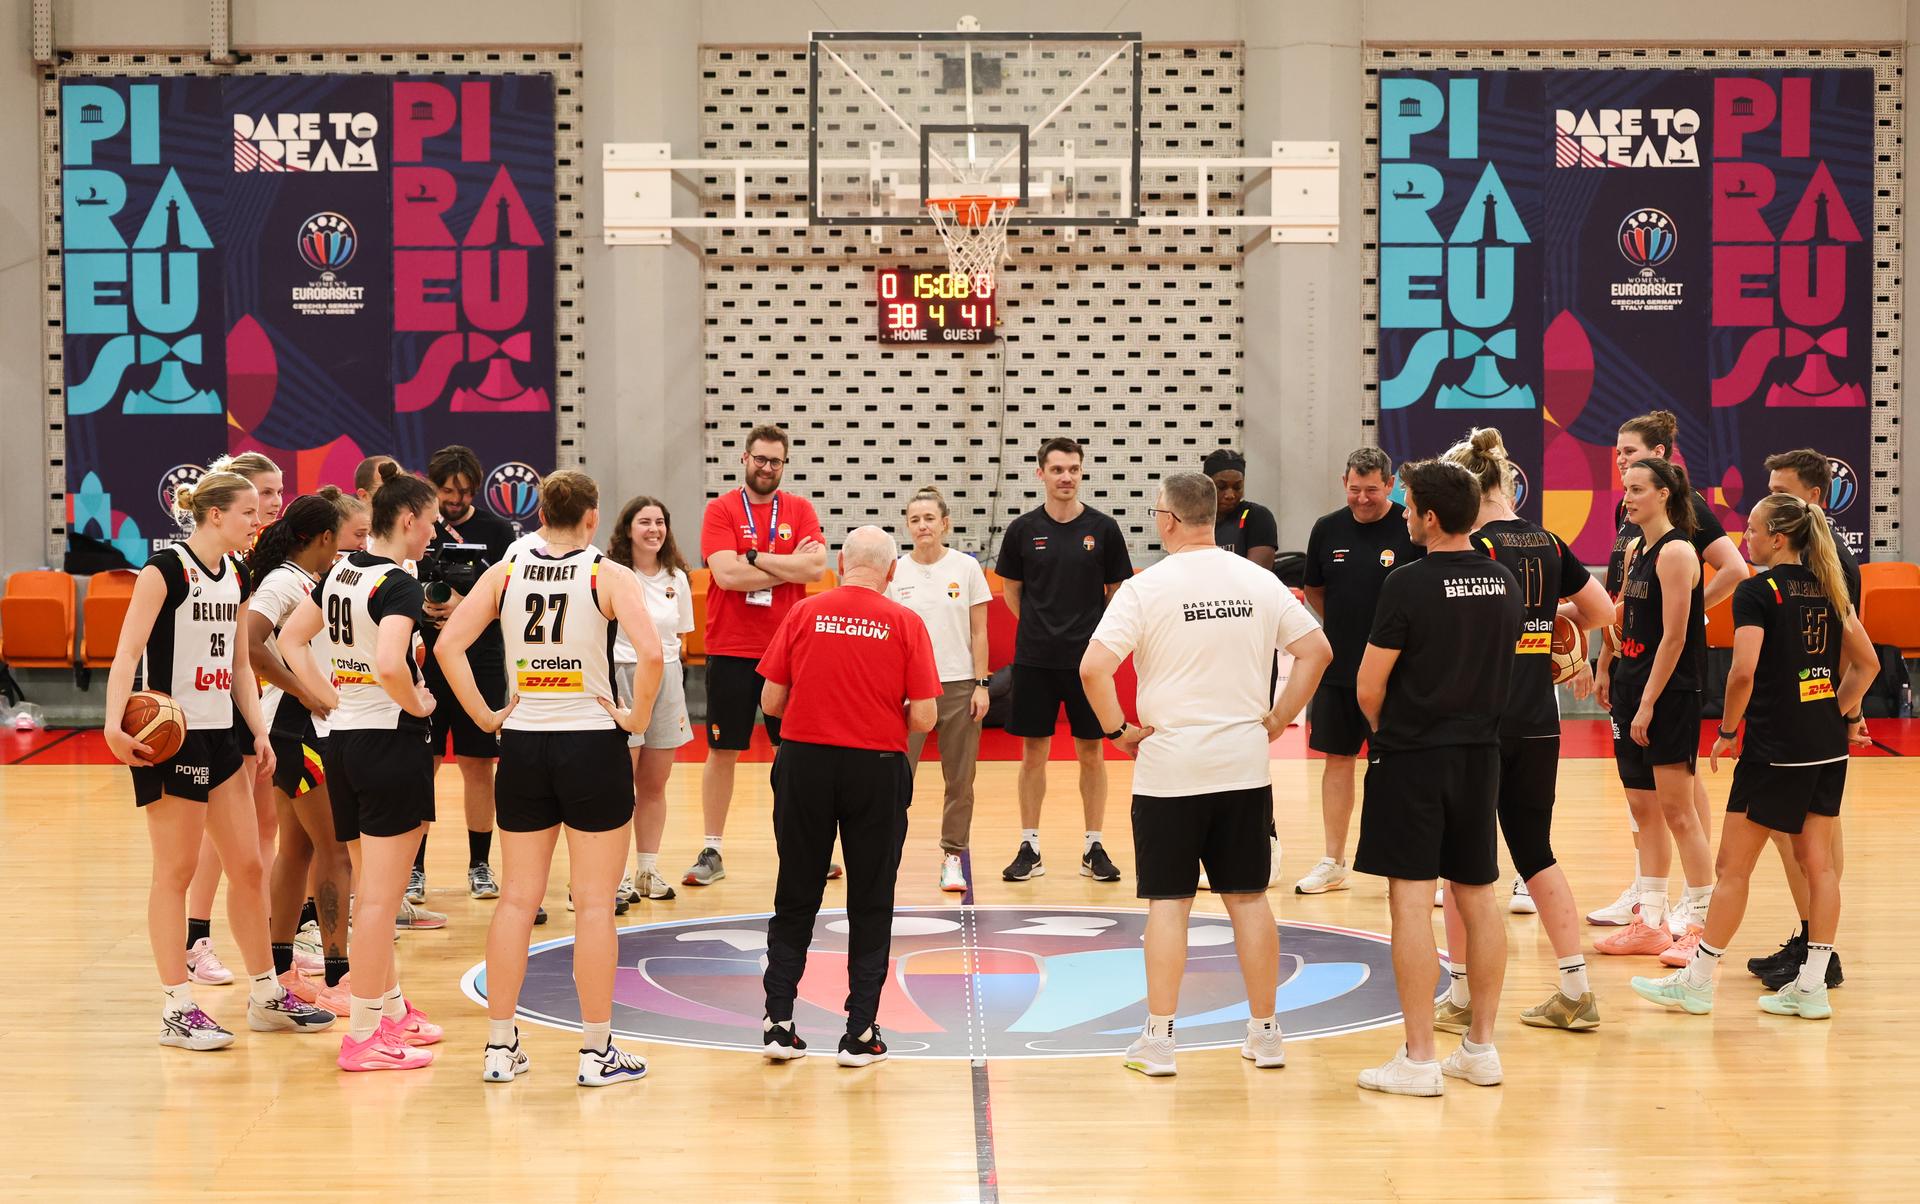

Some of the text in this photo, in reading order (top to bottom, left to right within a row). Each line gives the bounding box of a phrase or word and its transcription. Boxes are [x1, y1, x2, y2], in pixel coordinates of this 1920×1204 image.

[233, 112, 379, 140] DARE TO
[1556, 108, 1701, 136] DARE TO
[233, 139, 379, 173] DREAM
[1556, 135, 1701, 168] DREAM
[1628, 212, 1668, 228] 2025
[292, 286, 365, 301] EUROBASKET
[882, 273, 897, 298] 0
[1611, 283, 1683, 297] EUROBASKET
[887, 303, 992, 329] 38 4 41
[893, 329, 982, 341] HOME GUEST
[336, 567, 363, 587] JORIS
[523, 564, 579, 581] VERVAET
[1443, 576, 1505, 586] BASKETBALL
[1445, 584, 1507, 598] BELGIUM
[1183, 599, 1254, 610] BASKETBALL
[328, 593, 355, 648] 99
[523, 593, 569, 645] 27
[816, 614, 890, 630] BASKETBALL
[1184, 606, 1254, 622] BELGIUM
[815, 621, 889, 641] BELGIUM
[210, 633, 226, 658] 25
[531, 656, 582, 670] crelan
[525, 676, 572, 687] DHL
[175, 764, 210, 776] POWER
[193, 775, 210, 785] ADE
